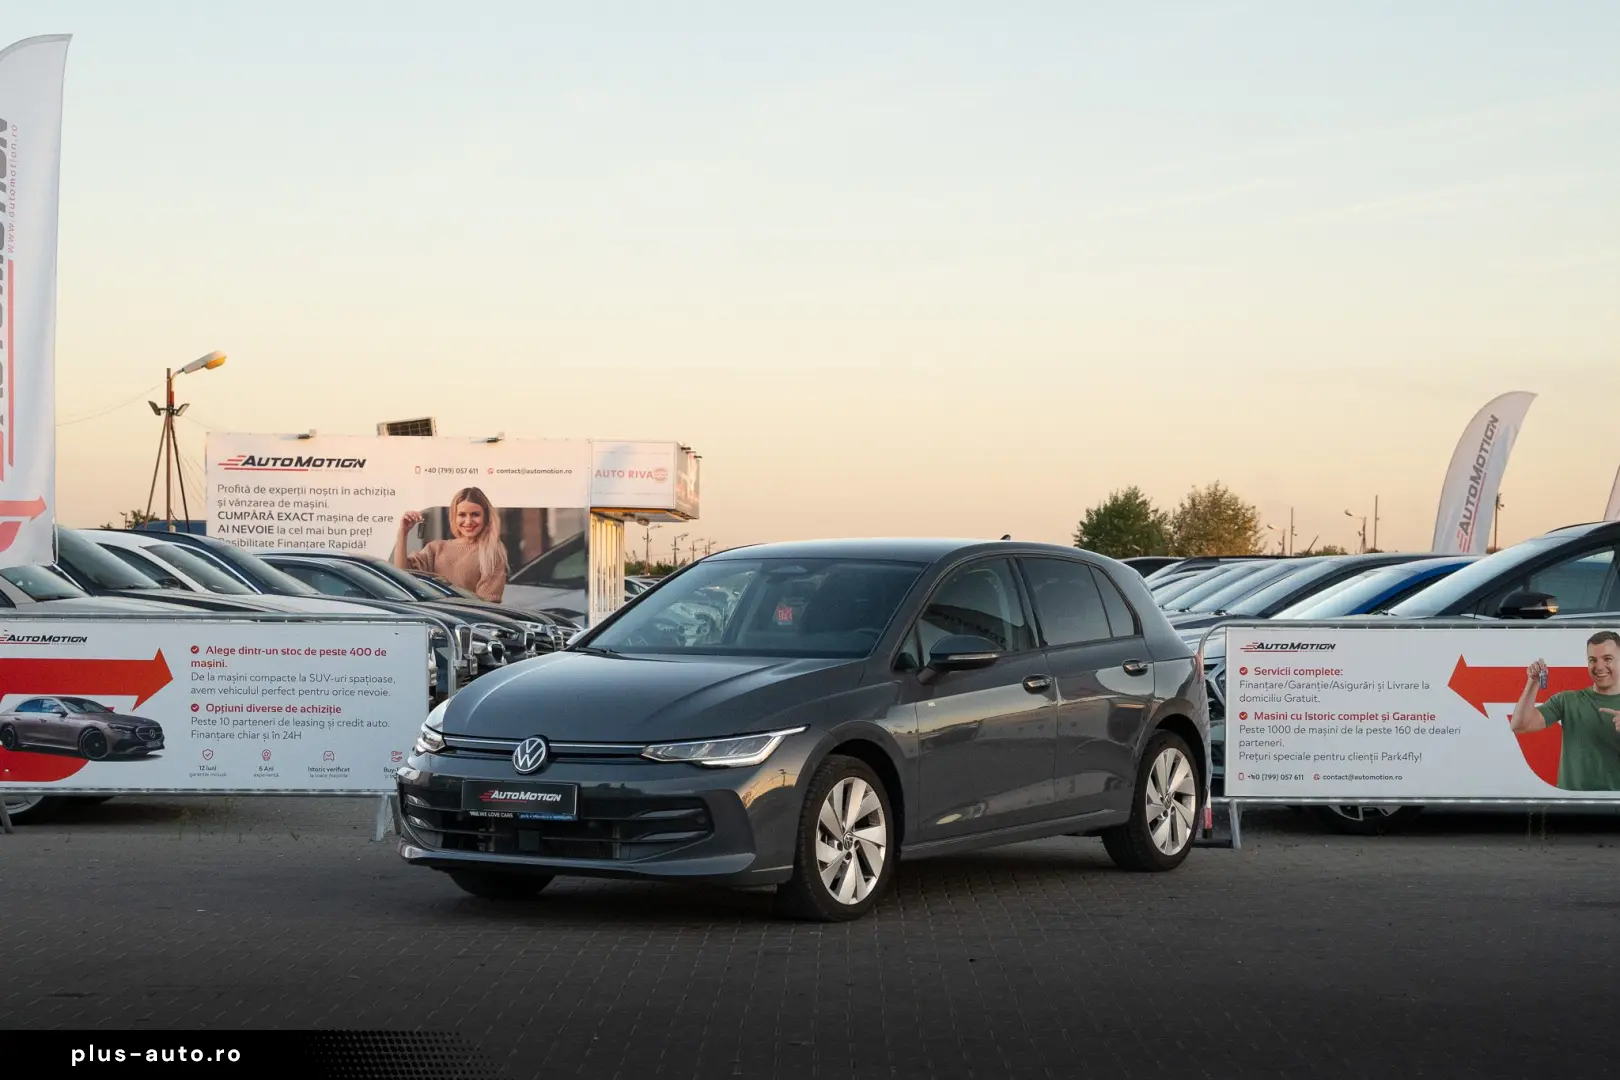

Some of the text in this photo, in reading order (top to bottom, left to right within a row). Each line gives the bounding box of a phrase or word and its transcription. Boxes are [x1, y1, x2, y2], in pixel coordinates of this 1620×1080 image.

[8, 124, 18, 254] www.automotion.ro
[438, 467, 454, 475] (799)
[496, 467, 573, 475] contact@automotion.ro
[595, 469, 653, 479] AUTO RIVA
[217, 484, 396, 497] Profită de experții noștri în achiziția
[217, 498, 330, 510] și vânzarea de mașini.
[217, 510, 394, 524] CUMPĂRĂ EXACT mașina de care
[217, 524, 373, 537] AI NEVOIE la cel mai bun preț!
[277, 539, 326, 550] Finanțare
[328, 539, 367, 550] Rapidă!
[205, 646, 387, 658] Alege dintr-un stoc de peste 400 de
[190, 659, 228, 670] mașini.
[1254, 667, 1344, 677] Servicii complete:
[191, 672, 396, 685] De la mașini compacte la SUV-uri spațioase,
[190, 686, 391, 697] avem vehiculul perfect pentru orice nevoie.
[1377, 681, 1385, 692] și
[1387, 681, 1419, 690] Livrare
[1421, 681, 1430, 690] la
[1239, 693, 1282, 703] domiciliu
[205, 703, 342, 716] Opțiuni diverse de achiziție
[191, 716, 390, 730] Peste 10 parteneri de leasing și credit auto.
[1305, 711, 1335, 720] Istoric
[1338, 712, 1379, 722] complet
[1381, 712, 1390, 723] și
[1392, 712, 1436, 723] Garanție
[191, 730, 302, 742] Finanțare chiar și în 24H
[1239, 725, 1461, 736] Peste 1000 de mașini de la peste 160 de dealeri
[1239, 751, 1422, 764] Prețuri speciale pentru clienții Park4fly!
[1261, 773, 1279, 781] (799)
